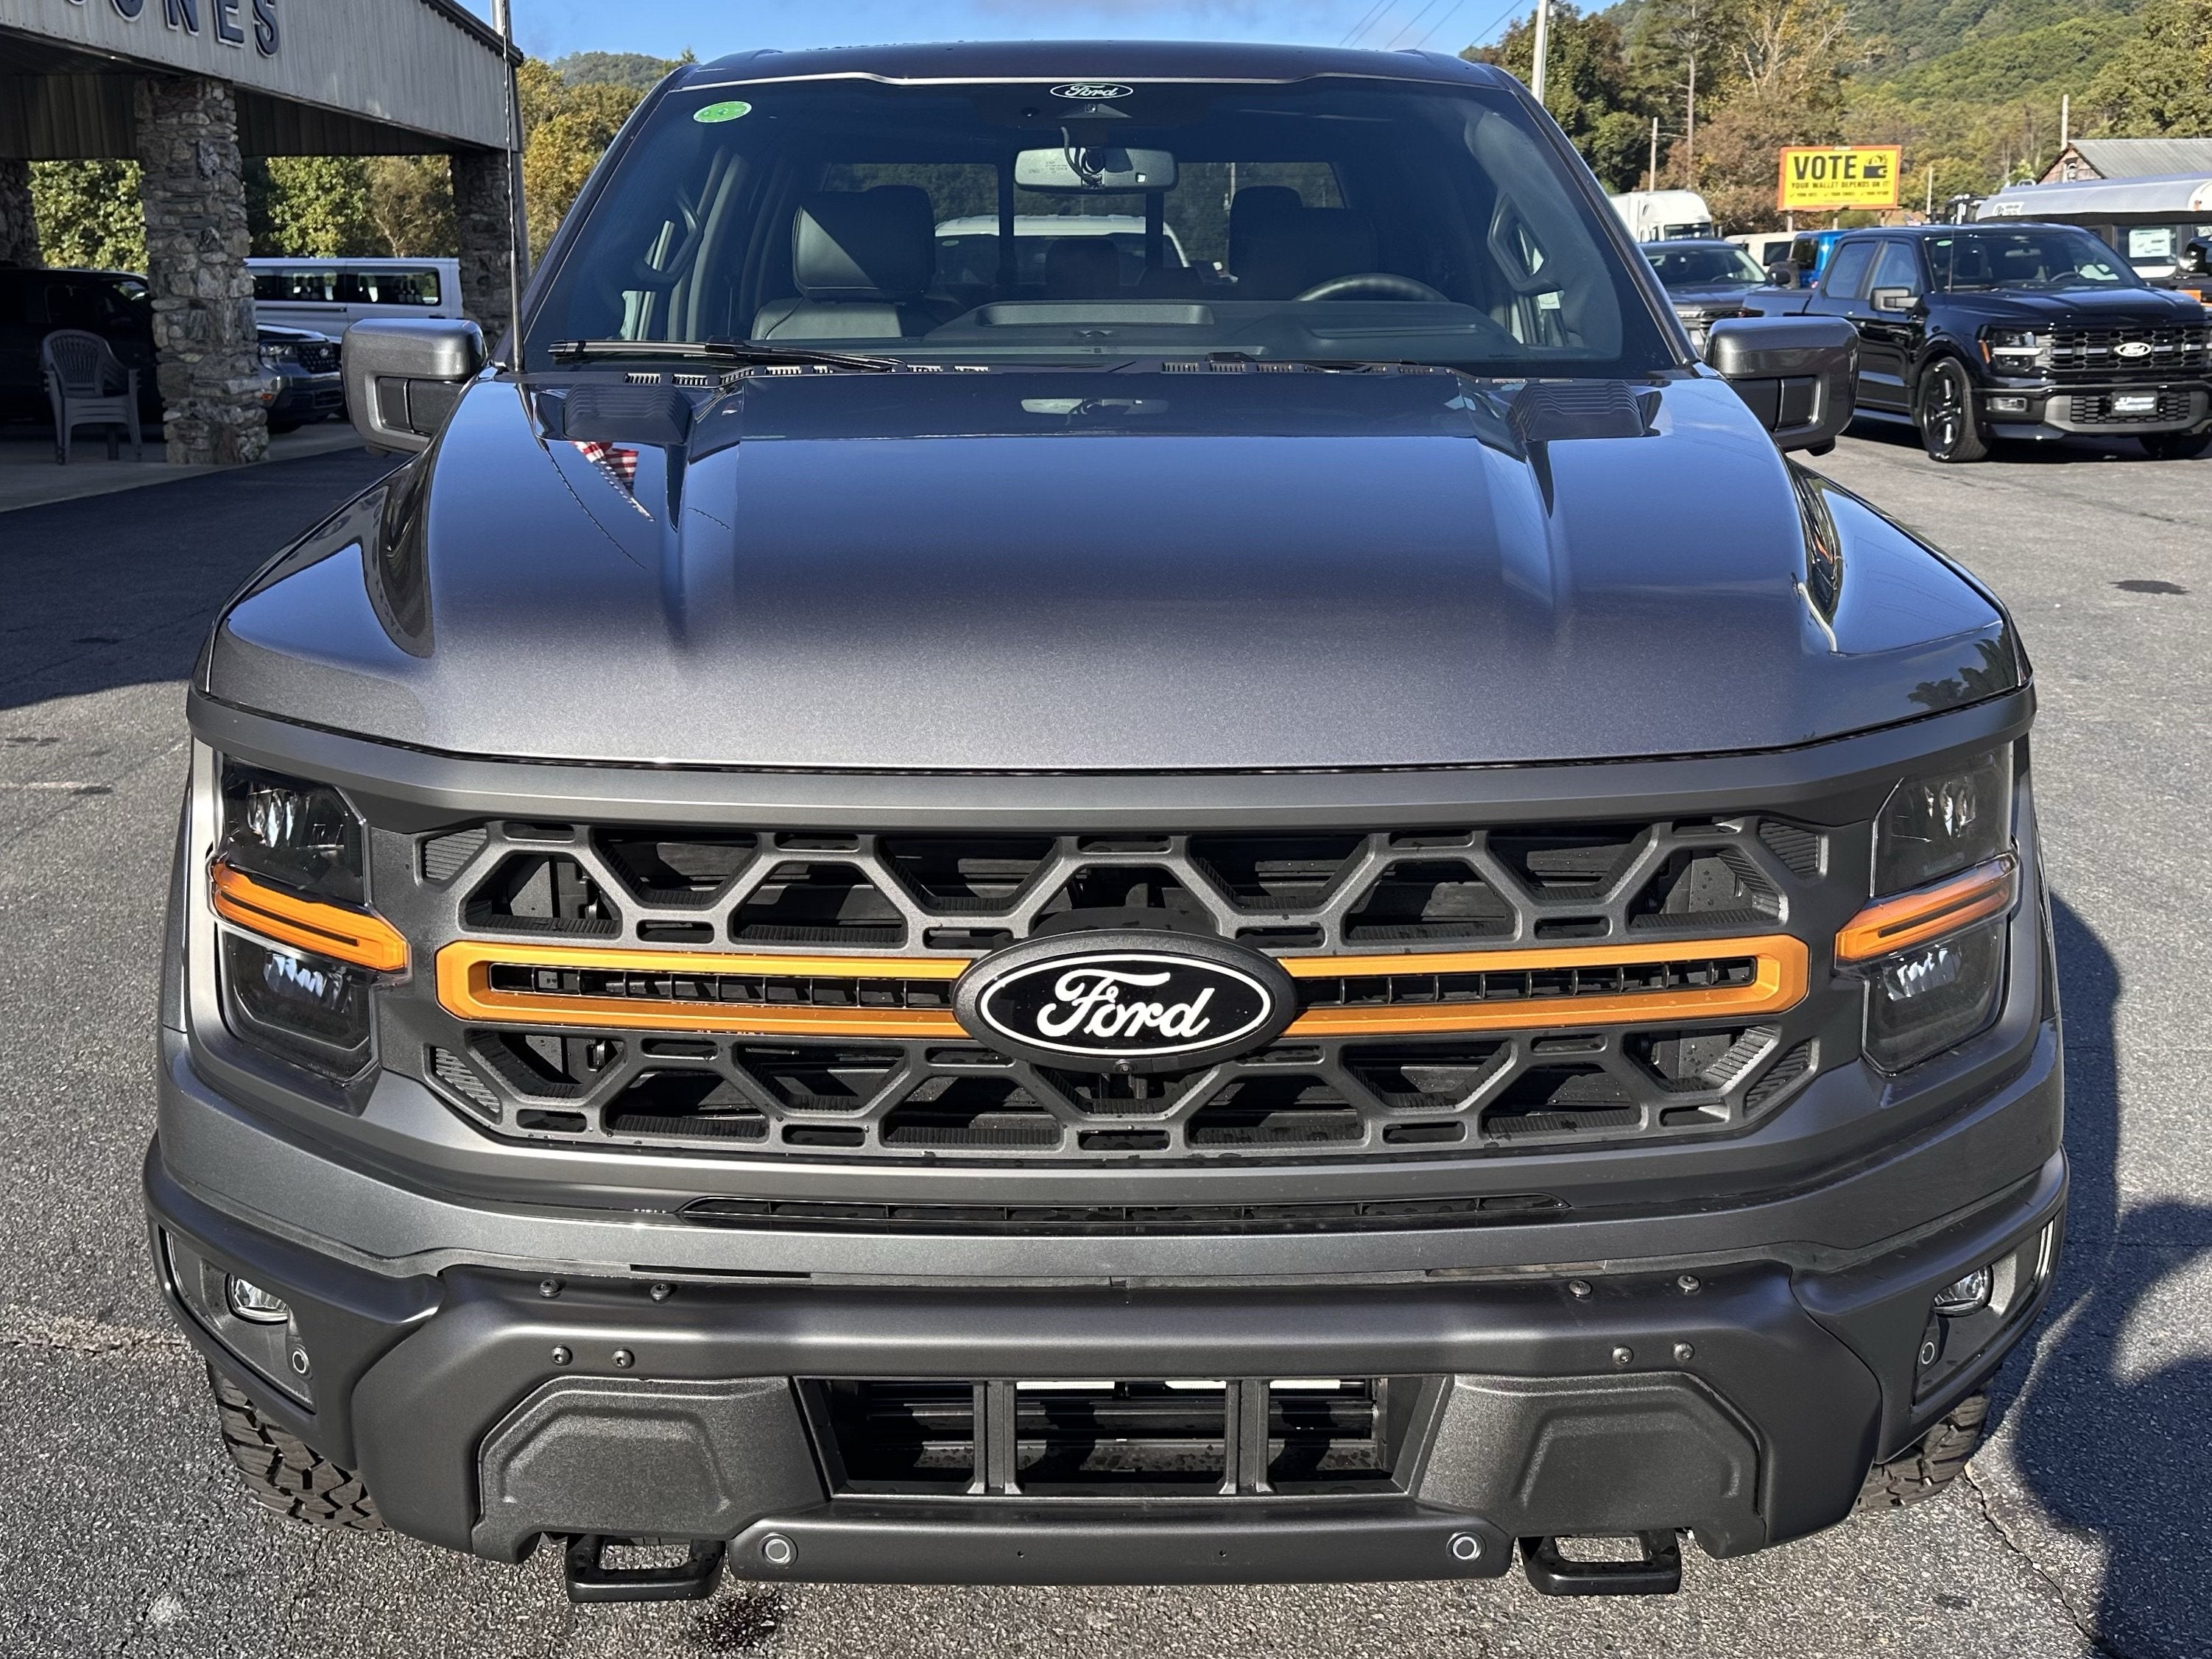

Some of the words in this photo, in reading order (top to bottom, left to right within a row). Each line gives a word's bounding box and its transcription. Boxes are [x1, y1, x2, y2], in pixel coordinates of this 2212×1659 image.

[68, 0, 280, 58] NES
[1064, 85, 1119, 96] Ford
[1794, 155, 1857, 180] VOTE
[1841, 180, 1870, 189] DEPENDS
[1037, 969, 1215, 1037] Ford
